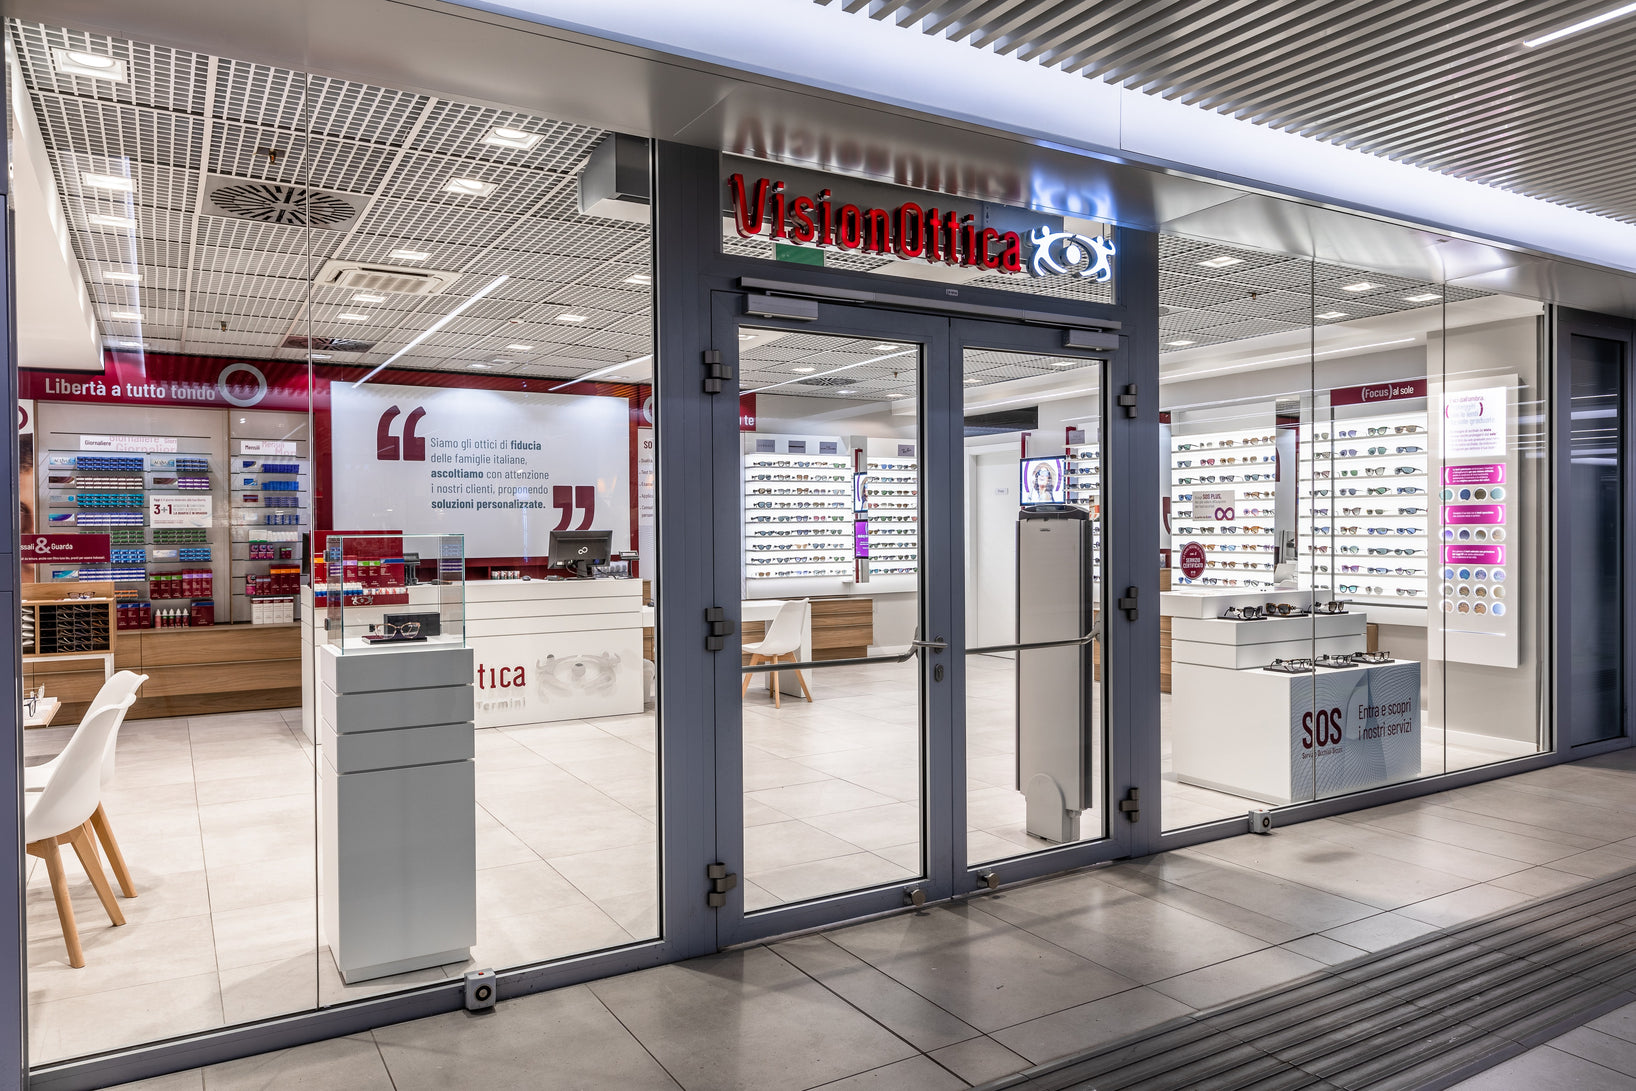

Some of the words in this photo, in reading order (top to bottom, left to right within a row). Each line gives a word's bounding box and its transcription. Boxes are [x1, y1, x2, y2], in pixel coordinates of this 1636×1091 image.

[728, 173, 1022, 275] VisionOttica
[45, 378, 106, 396] Libertà
[111, 384, 121, 397] a
[126, 383, 166, 398] tutto
[171, 385, 216, 400] tondo
[1393, 387, 1399, 396] al
[1400, 385, 1414, 395] sole
[744, 415, 755, 426] te
[84, 439, 112, 447] Giornaliere
[430, 437, 459, 449] Siamo
[461, 439, 472, 451] gli
[474, 440, 497, 449] ottici
[500, 440, 508, 450] di
[510, 440, 542, 450] fiducia
[430, 453, 452, 463] delle
[455, 454, 491, 466] famiglie
[493, 455, 528, 465] italiane,
[431, 468, 484, 479] ascoltiamo
[504, 470, 550, 480] attenzione
[431, 483, 434, 493] i
[436, 484, 463, 494] nostri
[465, 484, 496, 495] clienti,
[498, 485, 549, 496] proponendo
[153, 503, 173, 515] 3+1
[431, 499, 474, 509] soluzioni
[476, 499, 546, 511] personalizzate.
[35, 537, 51, 554] &
[477, 663, 526, 690] tica
[1358, 703, 1380, 720] Entra
[1381, 704, 1386, 717] e
[1387, 698, 1412, 718] scopri
[1302, 707, 1343, 750] SOS
[1358, 726, 1361, 741] i
[1363, 722, 1386, 740] nostri
[1387, 718, 1412, 736] servizi
